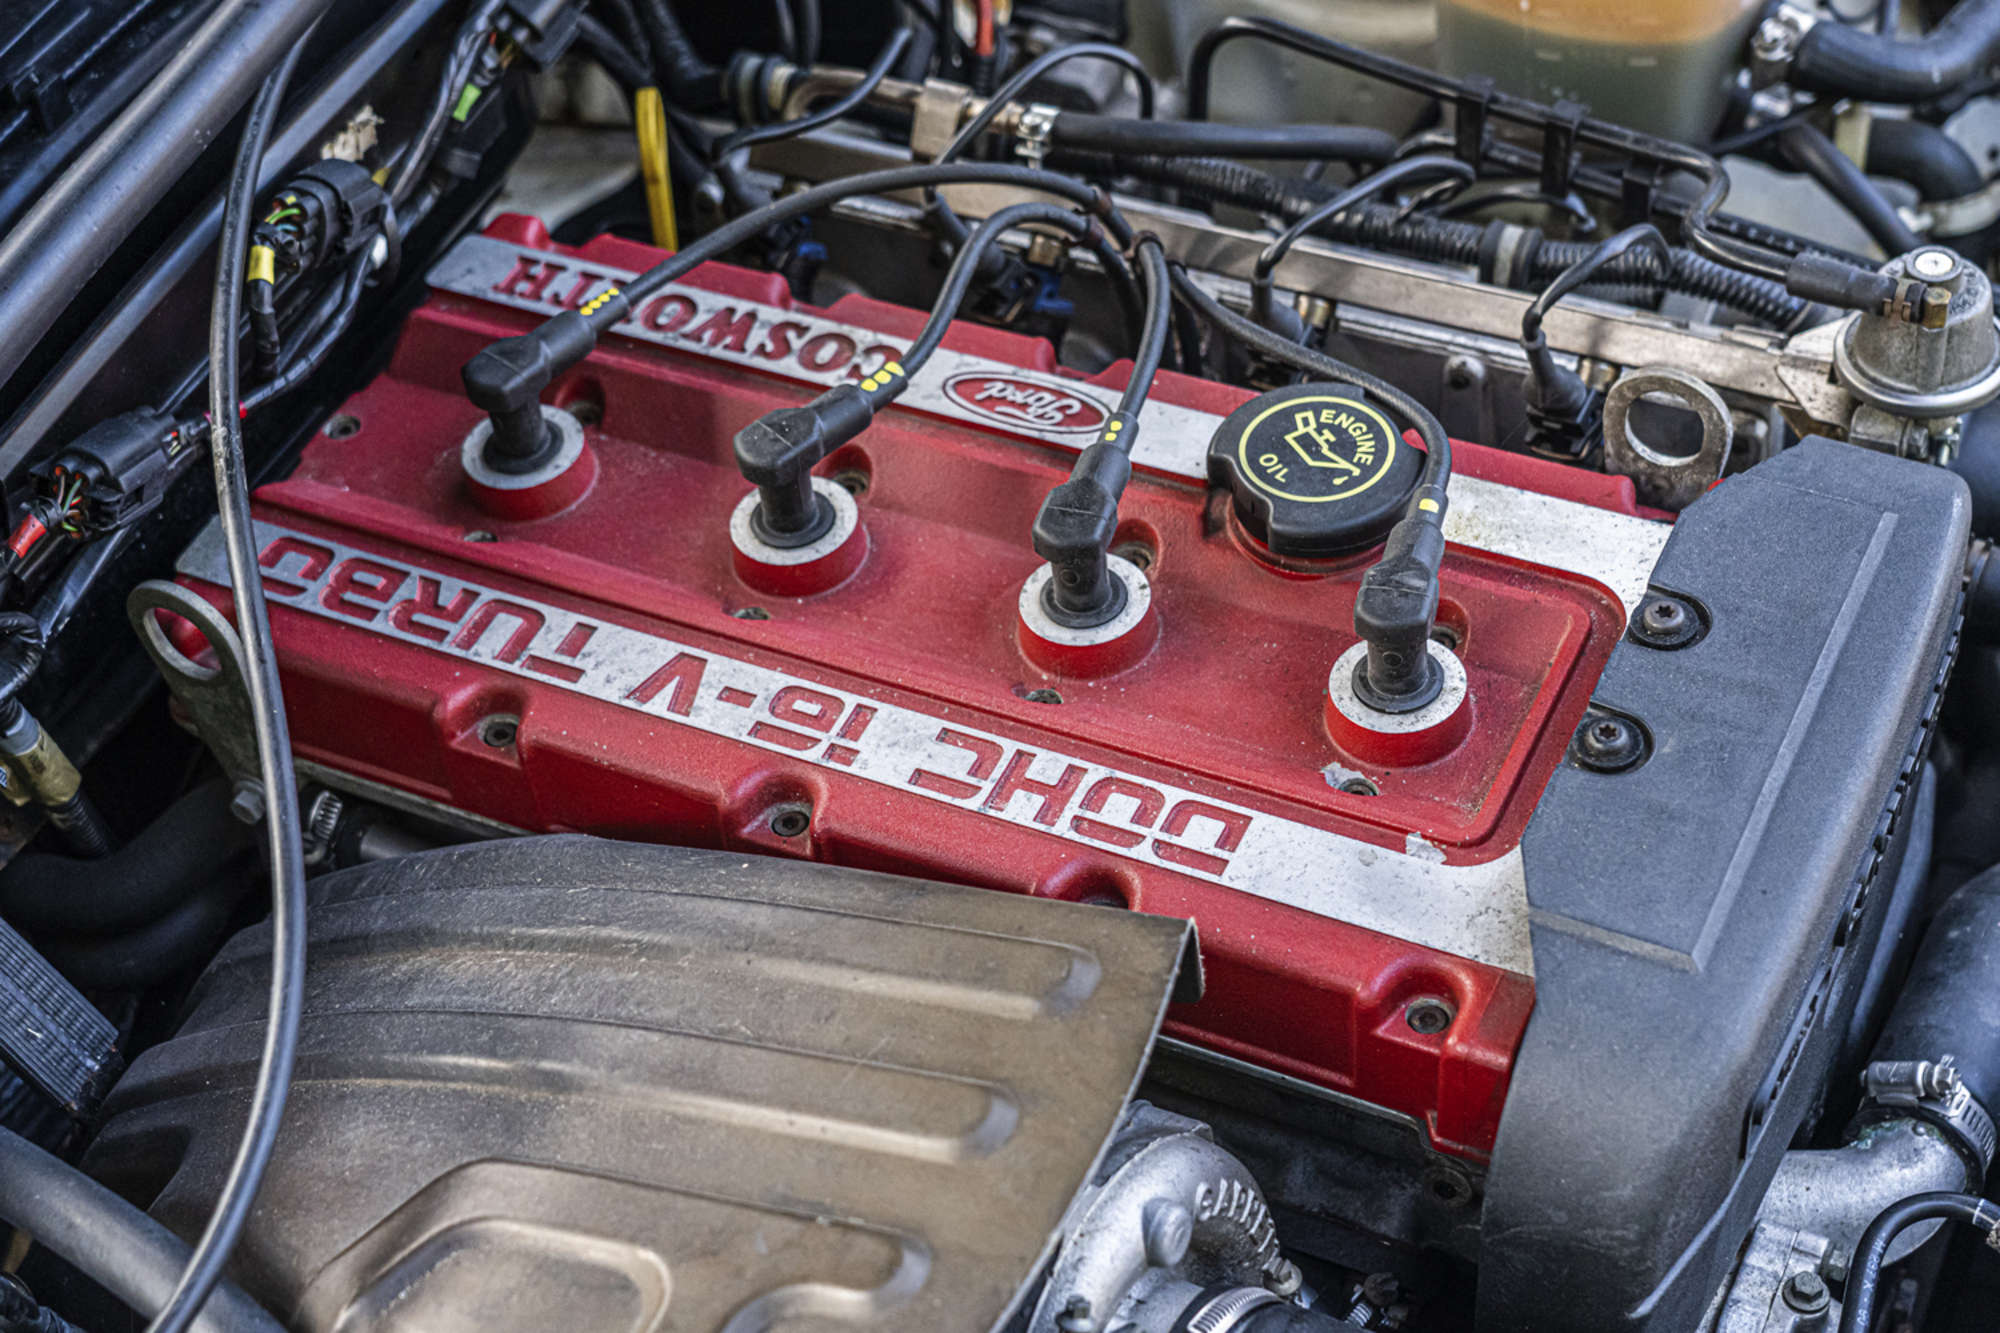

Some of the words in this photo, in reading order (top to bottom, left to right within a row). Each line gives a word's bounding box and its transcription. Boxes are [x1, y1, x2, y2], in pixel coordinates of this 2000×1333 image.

[492, 255, 904, 384] COSWOTH
[974, 380, 1083, 426] Ford
[1319, 408, 1376, 467] ENGINE
[1258, 452, 1290, 483] OIL
[258, 535, 599, 684] TURBO
[624, 651, 879, 768] 16-V
[907, 727, 1254, 877] DOHC
